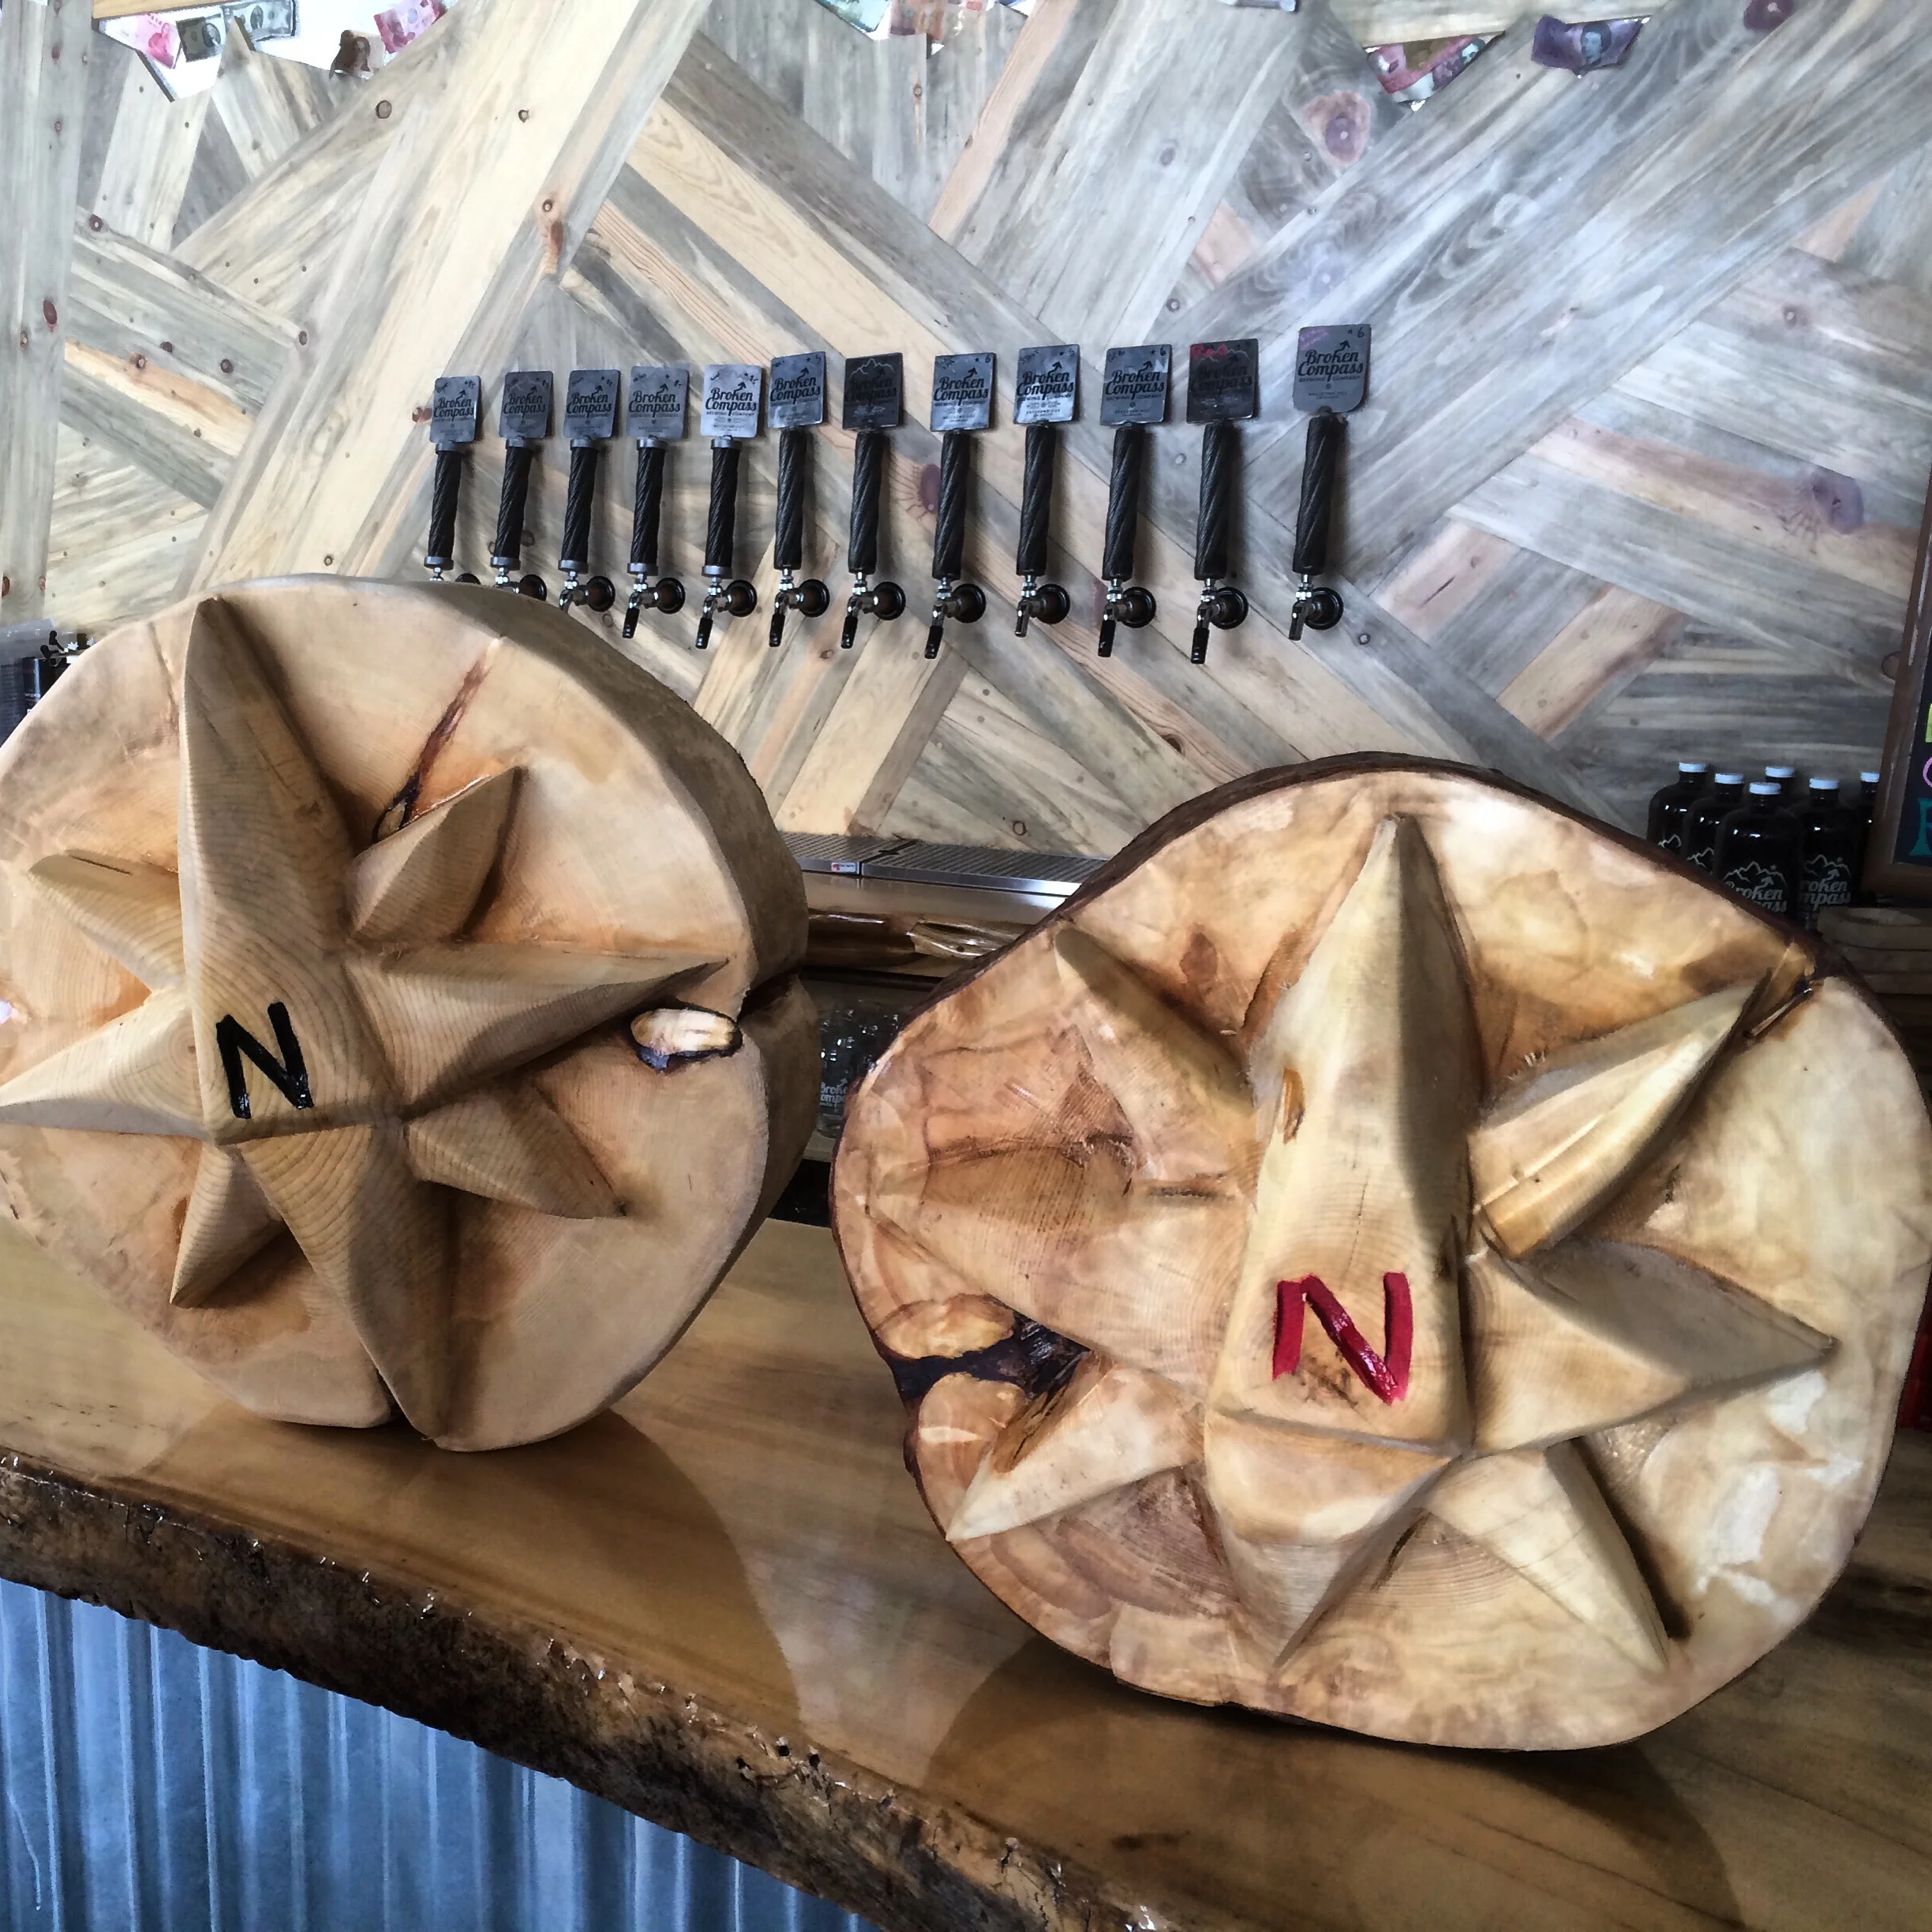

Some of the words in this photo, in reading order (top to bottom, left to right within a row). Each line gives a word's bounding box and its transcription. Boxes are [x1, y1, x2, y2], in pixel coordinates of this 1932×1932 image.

[1357, 327, 1365, 338] 6
[1305, 350, 1359, 365] Broken
[1022, 371, 1069, 384] Broken
[1112, 370, 1160, 384] Broken
[1298, 361, 1363, 381] Compass
[775, 376, 816, 391] Broken
[939, 377, 984, 391] Broken
[1017, 381, 1074, 400] Compass
[1105, 382, 1165, 400] Compass
[509, 394, 542, 404] Broken
[572, 393, 608, 404] Broken
[635, 391, 676, 403] Broken
[711, 388, 753, 401] Broken
[770, 386, 821, 404] Compass
[934, 388, 988, 406] Compass
[438, 397, 472, 408] Broken
[503, 402, 546, 418] Compass
[567, 402, 612, 418] Compass
[628, 402, 680, 417] Compass
[706, 398, 756, 416] Compass
[433, 406, 474, 421] Compass
[215, 1002, 315, 1119] N
[1271, 1271, 1413, 1406] N
